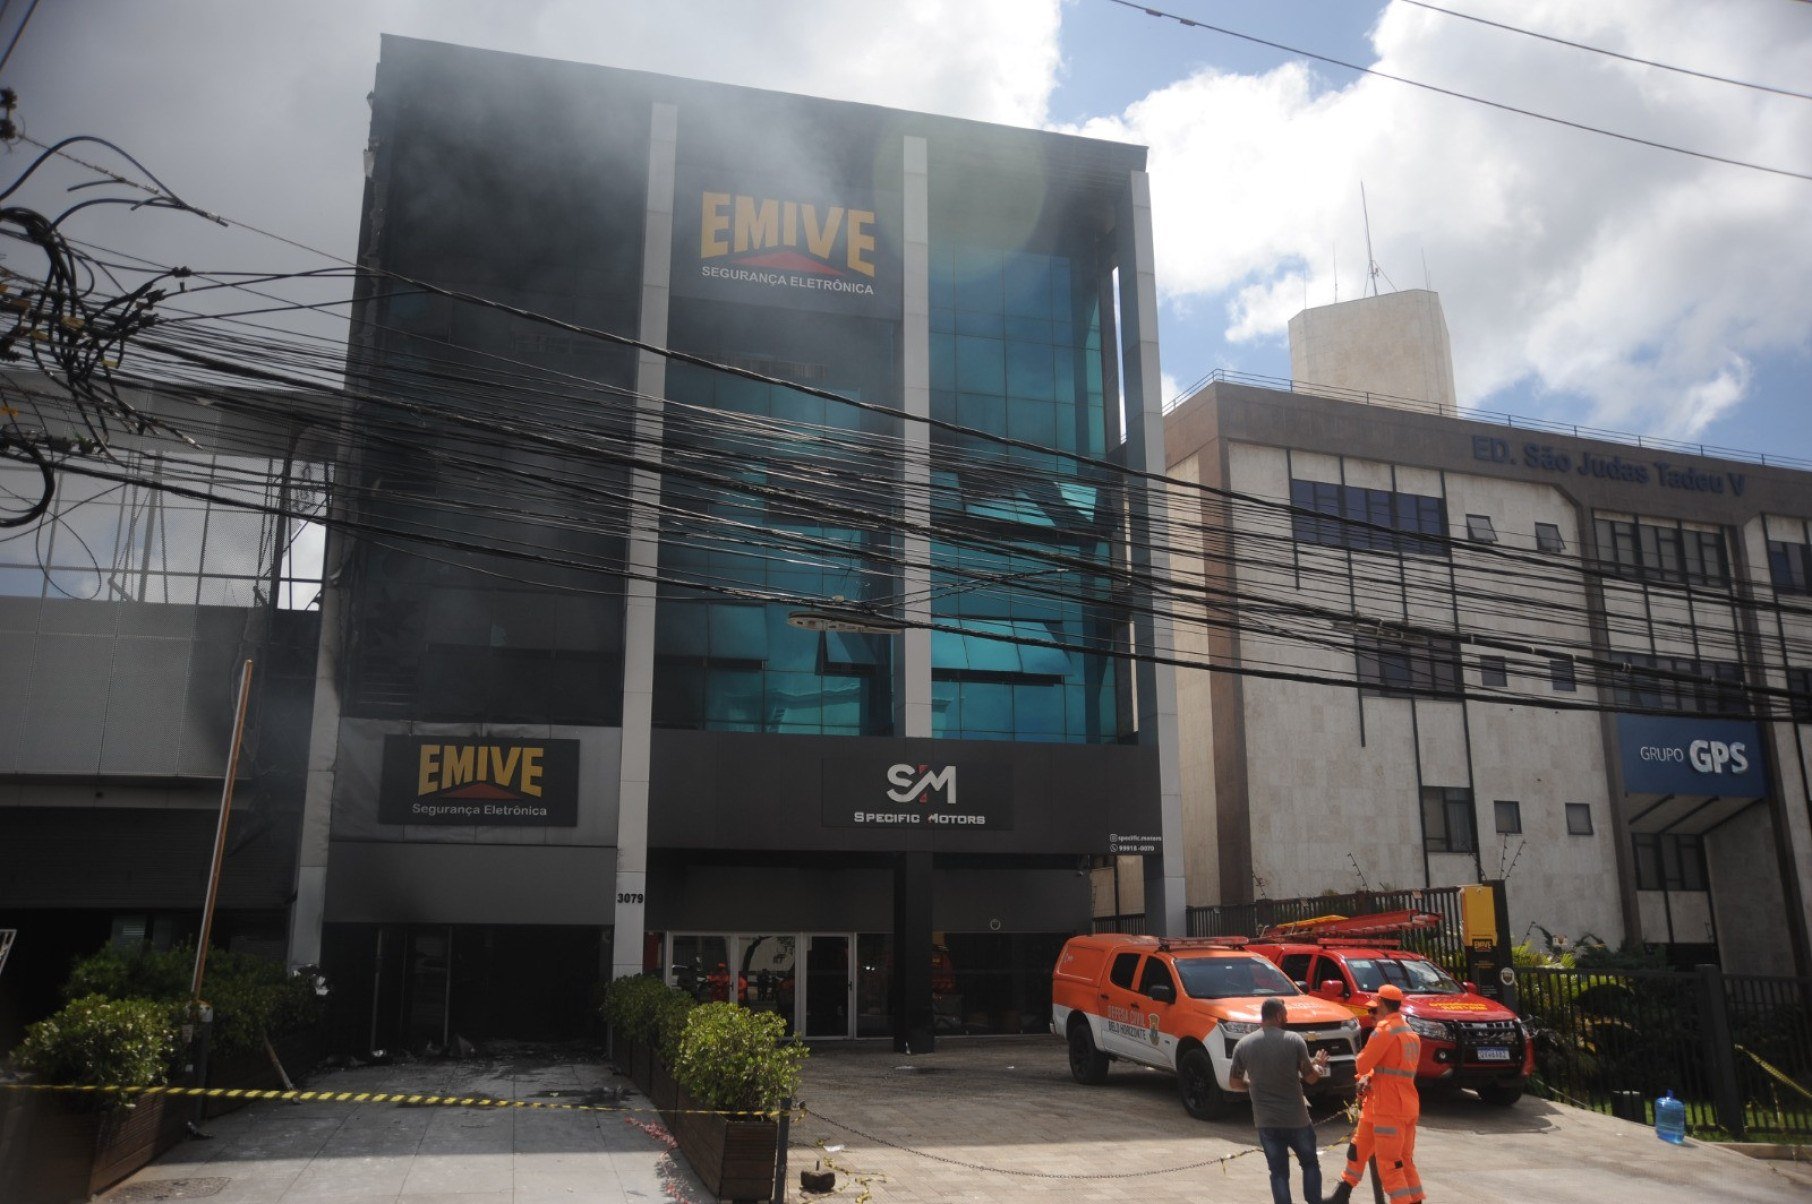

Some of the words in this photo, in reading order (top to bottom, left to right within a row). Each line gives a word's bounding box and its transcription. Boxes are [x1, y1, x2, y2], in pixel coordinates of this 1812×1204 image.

[700, 191, 875, 277] EMIVE
[702, 266, 787, 286] SEGURANÇA
[790, 276, 874, 295] ELETRÔNICA
[1472, 435, 1517, 465] ED.
[1524, 442, 1572, 473] São
[1577, 452, 1649, 484] Judas
[1653, 461, 1723, 494] Tadeu
[1727, 472, 1746, 497] V
[418, 744, 544, 798] EMIVE
[1640, 746, 1684, 763] GRUPO
[1689, 739, 1748, 774] GPS
[412, 803, 480, 816] Segurança
[484, 804, 547, 816] Eletrônica
[854, 811, 920, 824] SPECIFIC
[928, 813, 986, 825] MOTORS
[617, 893, 644, 904] 3079
